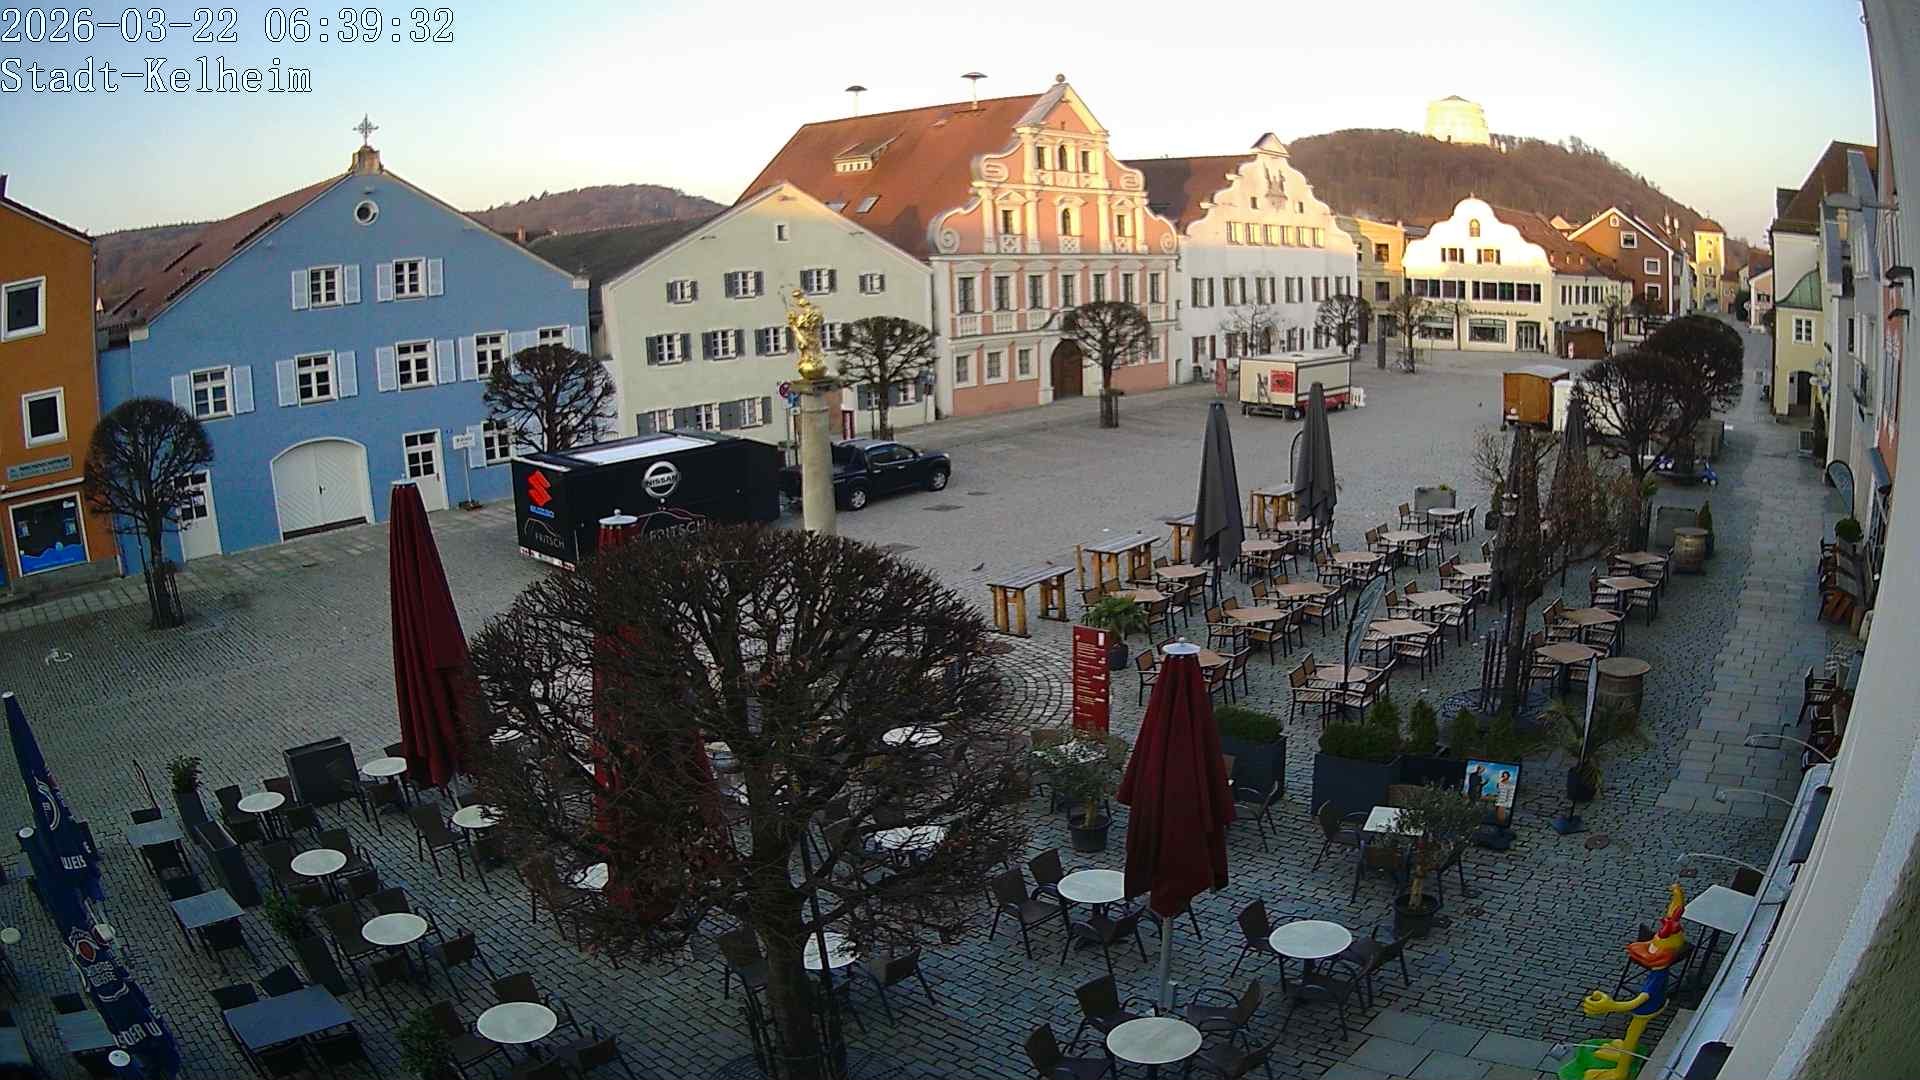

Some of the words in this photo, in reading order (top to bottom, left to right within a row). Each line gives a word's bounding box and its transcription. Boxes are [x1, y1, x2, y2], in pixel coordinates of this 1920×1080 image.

[647, 473, 679, 487] NISSAN
[649, 519, 707, 542] FRITSCH
[535, 532, 565, 549] FRITSCH
